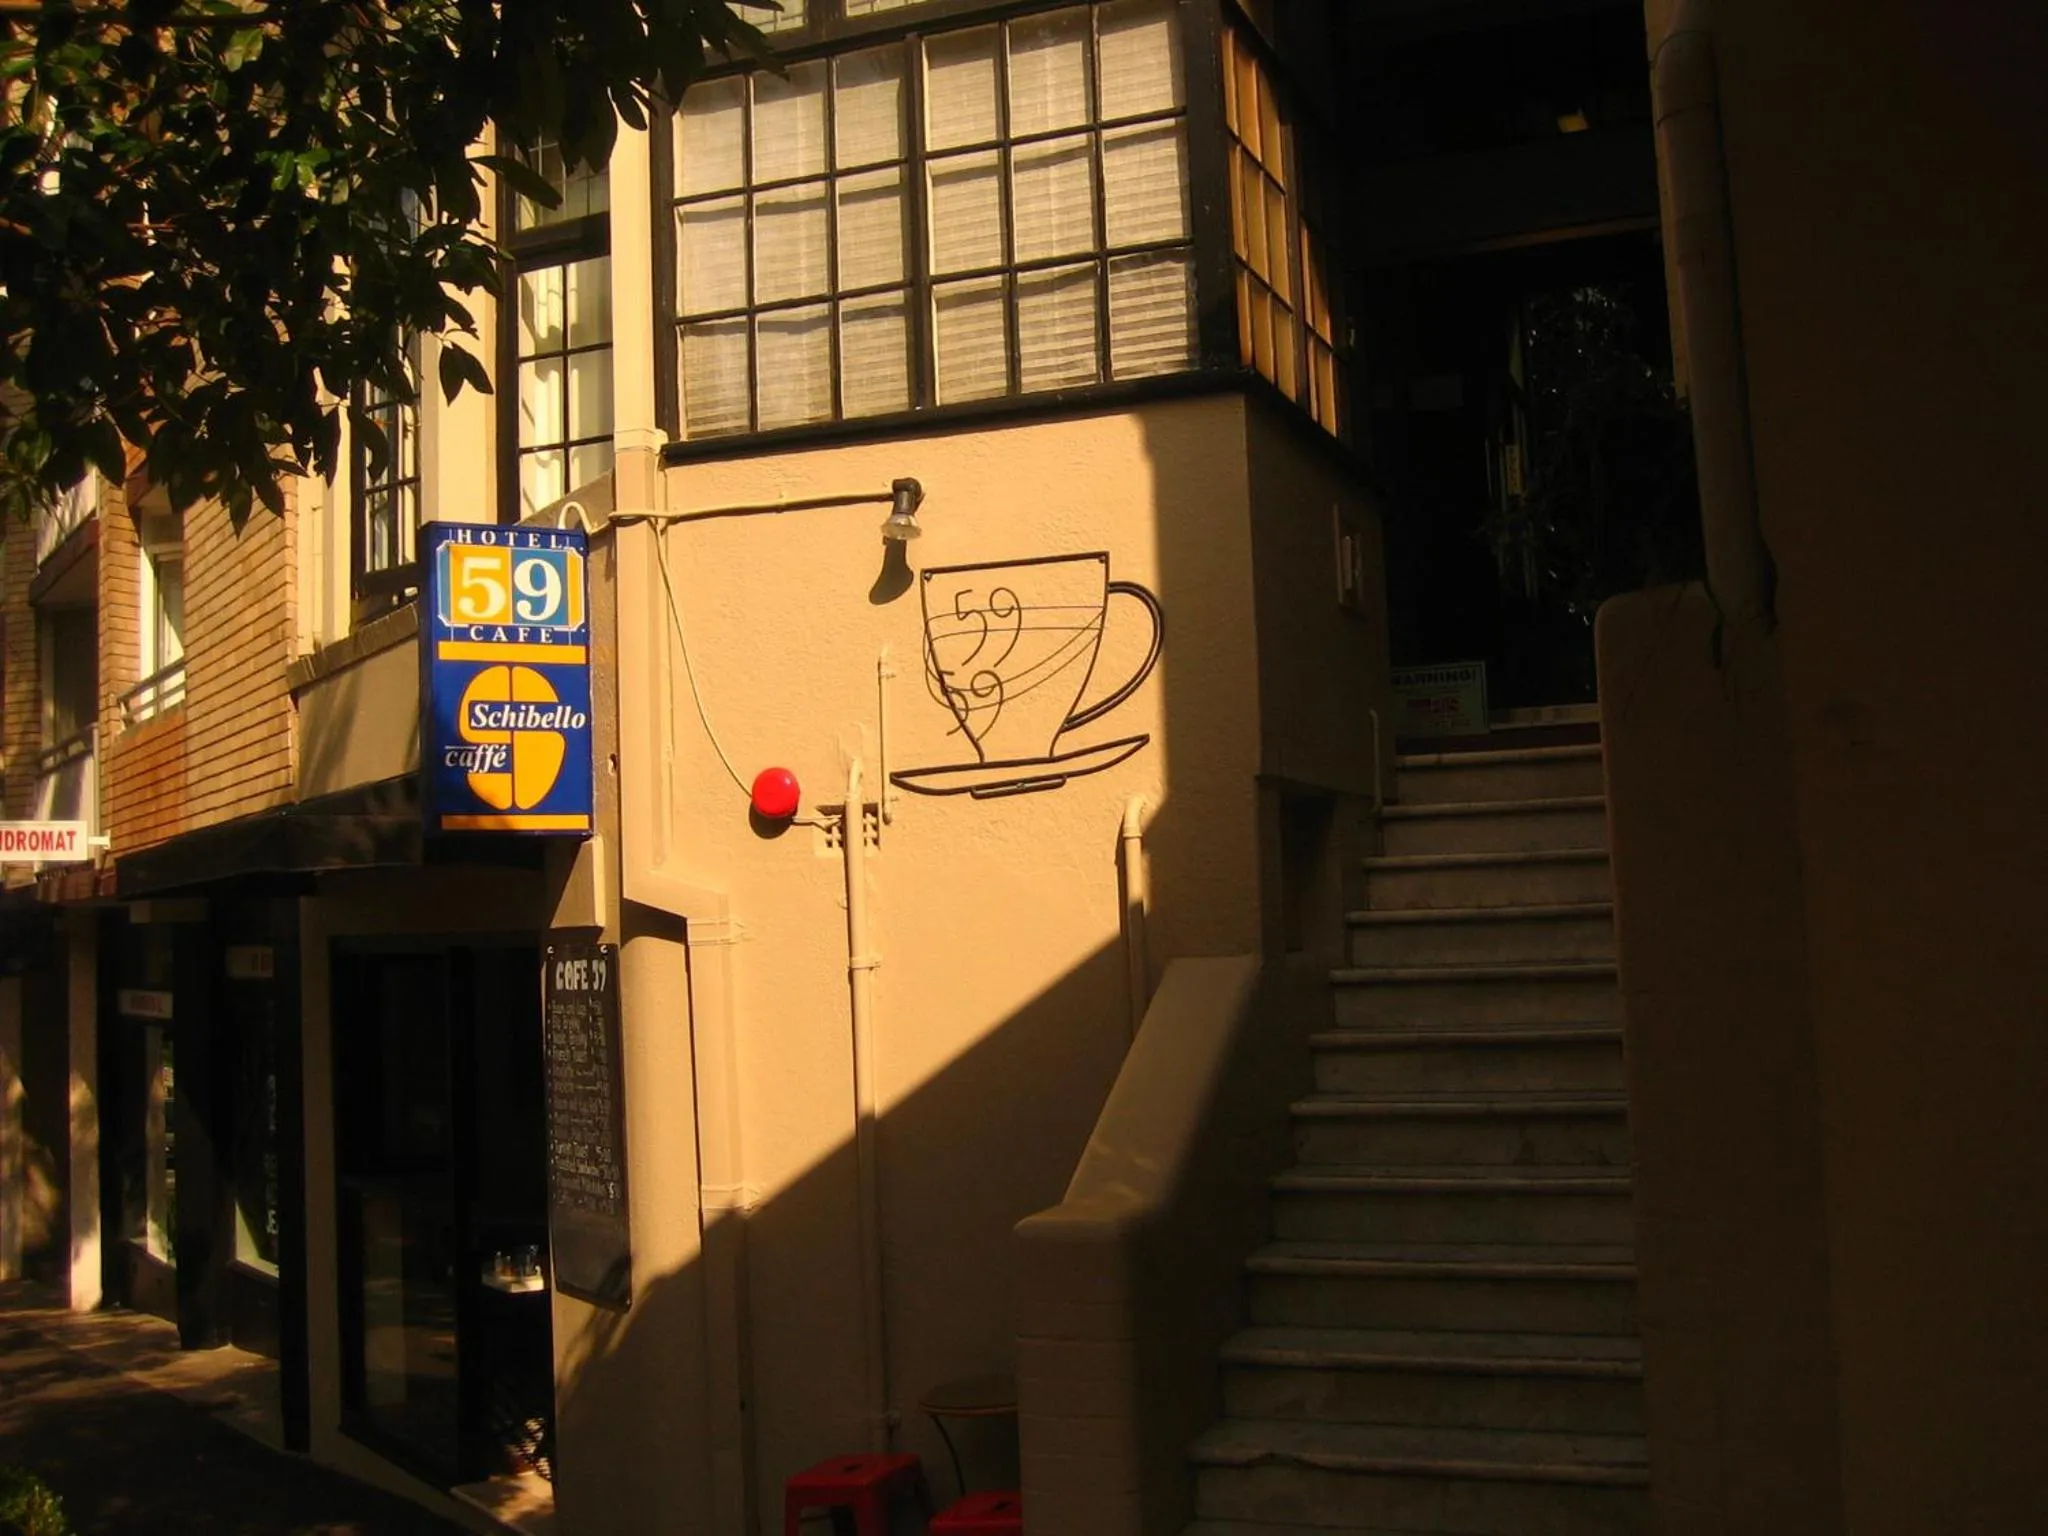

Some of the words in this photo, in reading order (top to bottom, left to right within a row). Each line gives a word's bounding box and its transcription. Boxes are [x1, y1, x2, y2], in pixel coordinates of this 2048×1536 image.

[457, 529, 563, 549] HOTEL
[457, 557, 562, 622] 59
[469, 626, 554, 644] CAFE
[954, 587, 1022, 668] 59
[470, 703, 586, 729] Schibello
[445, 744, 508, 774] caffé
[0, 830, 77, 852] DROMAT
